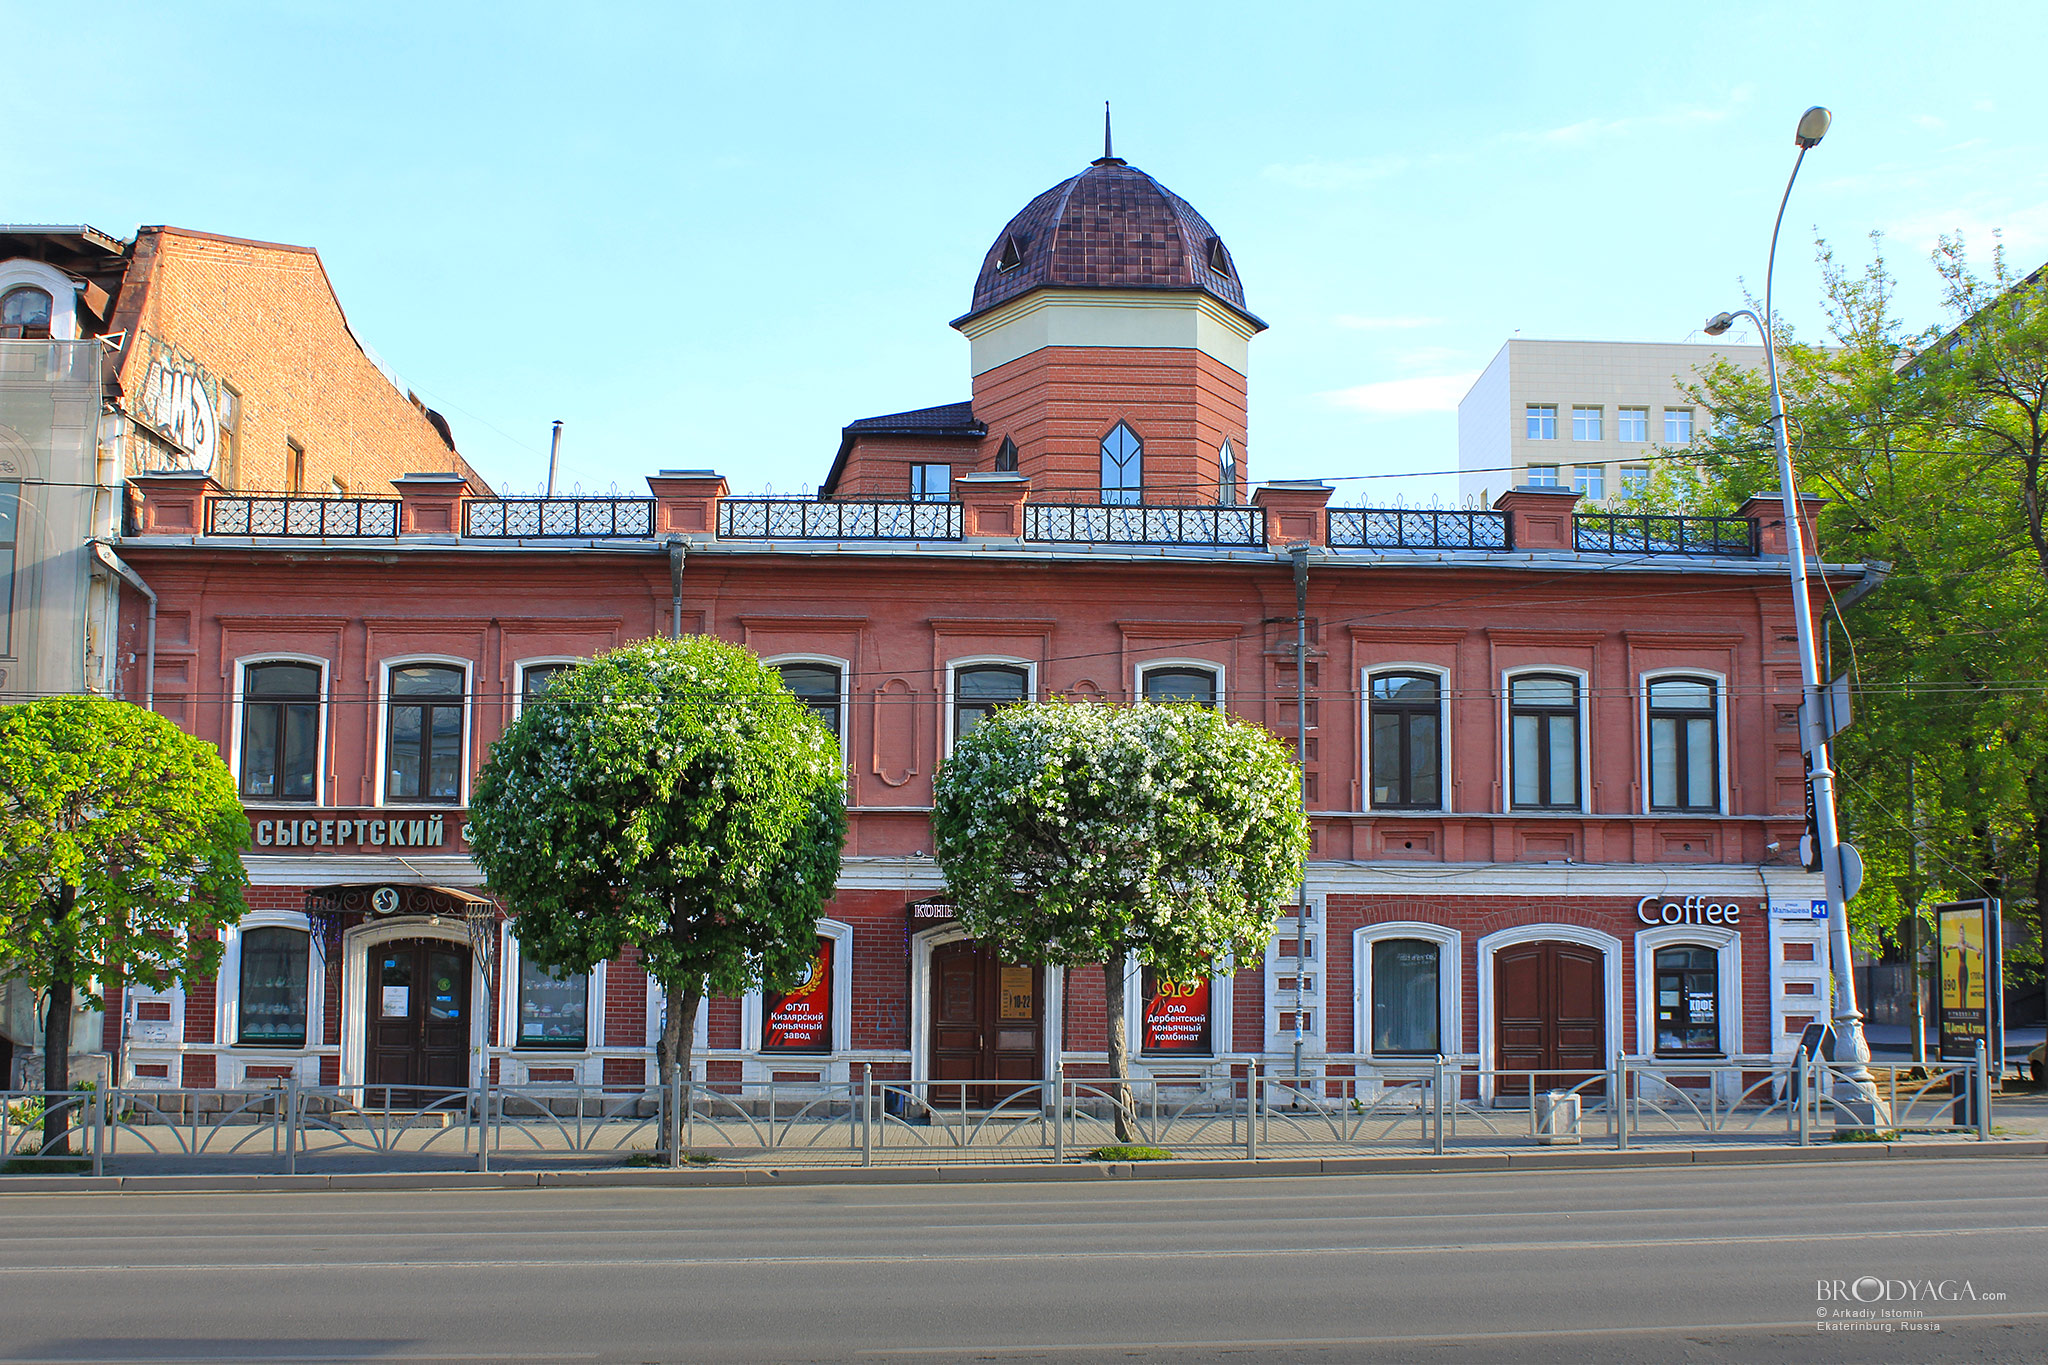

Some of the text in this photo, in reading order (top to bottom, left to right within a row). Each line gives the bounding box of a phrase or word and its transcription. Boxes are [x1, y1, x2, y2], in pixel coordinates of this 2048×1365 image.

[256, 814, 443, 846] СЫСЕРТСКИЙ
[1637, 895, 1740, 924] Coffee
[1812, 904, 1826, 915] 41
[1014, 995, 1031, 1008] 10-22
[1689, 999, 1714, 1011] КОФЕ
[785, 1003, 810, 1011] ФГУП
[1167, 1005, 1187, 1013] ОАО
[770, 1012, 824, 1022] Кизлярский
[1147, 1014, 1206, 1023] Дербентский
[772, 1022, 822, 1030] коньячный
[1152, 1023, 1202, 1031] коньячный
[783, 1032, 811, 1040] завод
[1155, 1032, 1199, 1041] комбинат
